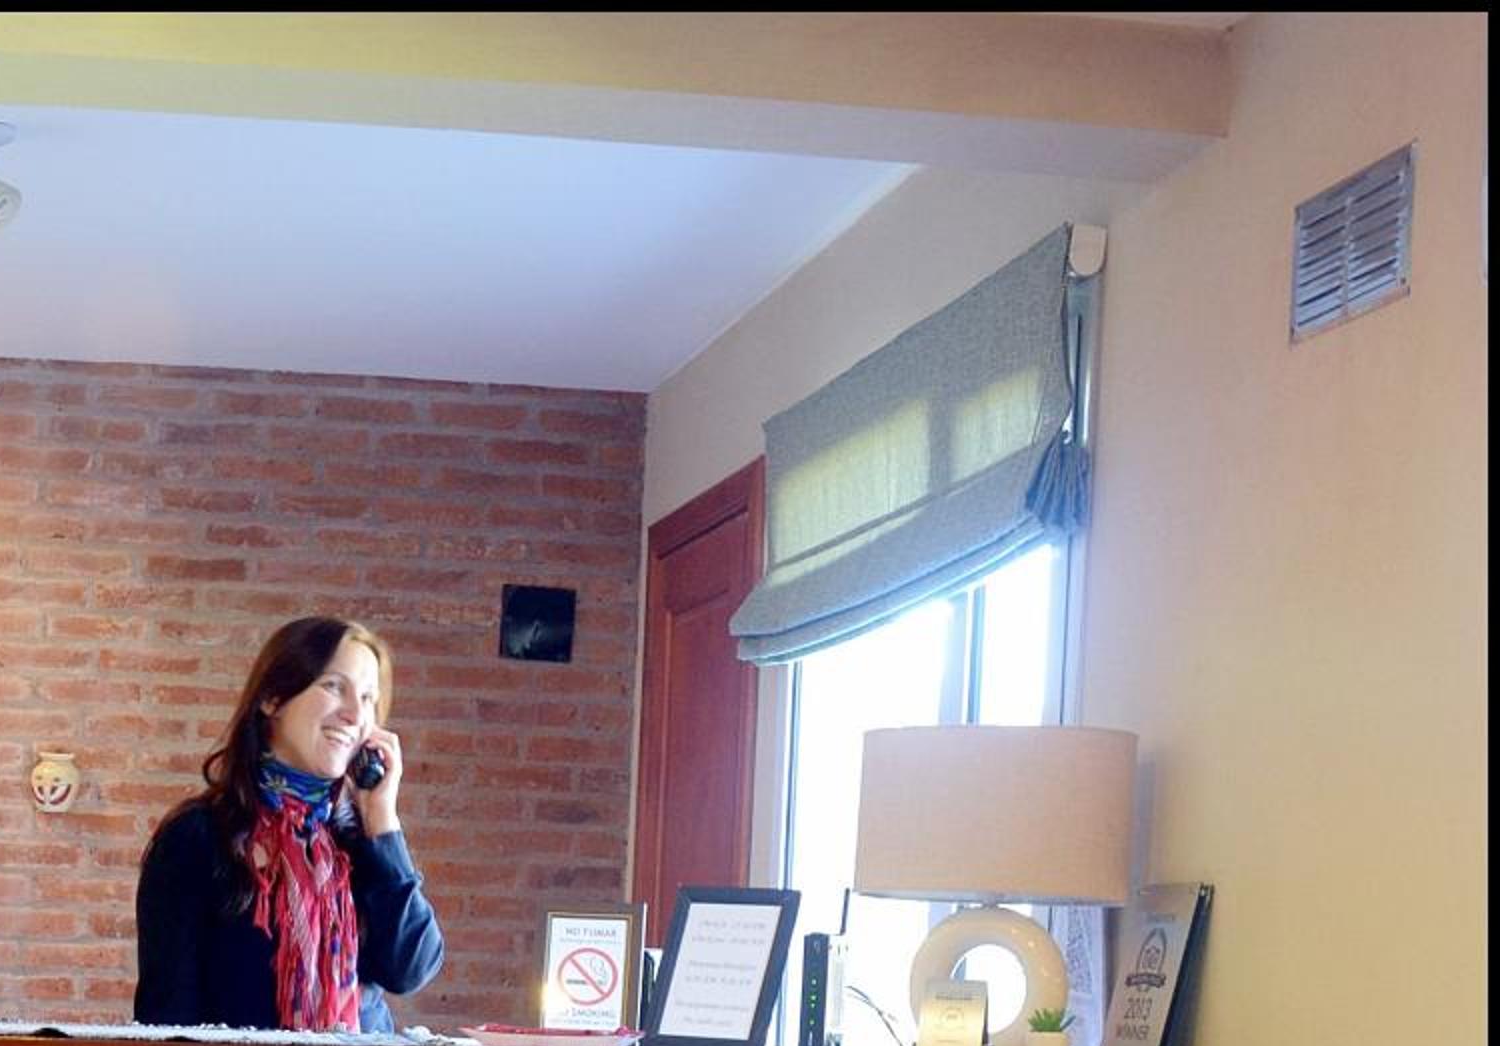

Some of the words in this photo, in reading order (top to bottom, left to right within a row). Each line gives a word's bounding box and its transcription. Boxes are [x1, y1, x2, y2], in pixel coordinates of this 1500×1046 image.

[565, 927, 580, 937] NO
[583, 927, 617, 938] FUMAR
[1115, 1023, 1151, 1041] WINNER
